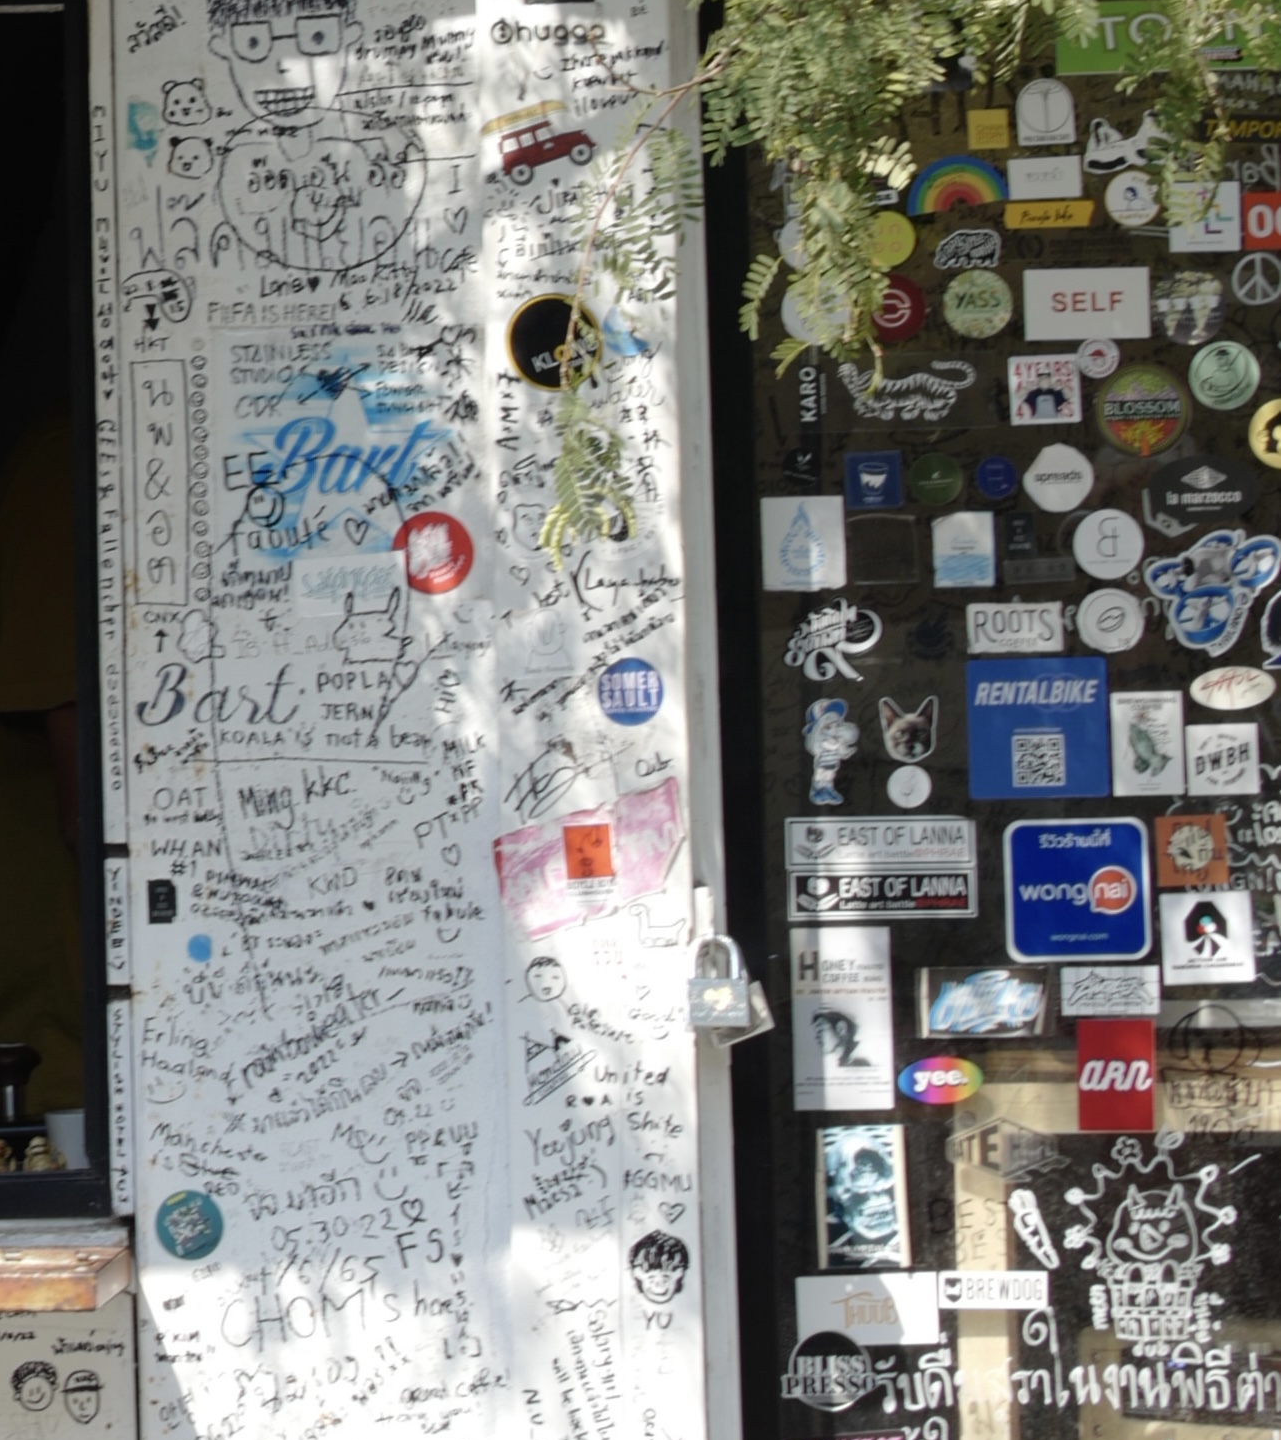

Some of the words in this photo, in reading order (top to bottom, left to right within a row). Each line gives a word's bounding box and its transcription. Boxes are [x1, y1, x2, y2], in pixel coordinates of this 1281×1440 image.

[954, 289, 1002, 311] YASS
[1050, 291, 1125, 314] SELF
[799, 365, 817, 424] KARO
[1102, 399, 1183, 417] BLOSSOM
[254, 418, 436, 495] Bart
[1165, 491, 1184, 504] la
[1186, 488, 1243, 505] marzocco
[973, 607, 1058, 636] ROOTS
[601, 670, 659, 691] SOMER
[974, 678, 1098, 707] RENTALBIKE
[601, 689, 660, 708] SAULT
[1194, 740, 1252, 778] DWBH
[838, 826, 880, 848] EAST
[882, 826, 908, 847] OF
[910, 824, 965, 847] LANNA
[838, 876, 881, 898] EAST
[883, 876, 909, 897] OF
[911, 876, 968, 898] LANNA
[911, 1067, 969, 1093] yee.
[964, 1276, 1044, 1301] BREWDOG
[795, 1354, 865, 1376] BLISS
[786, 1373, 877, 1397] PRESSO
